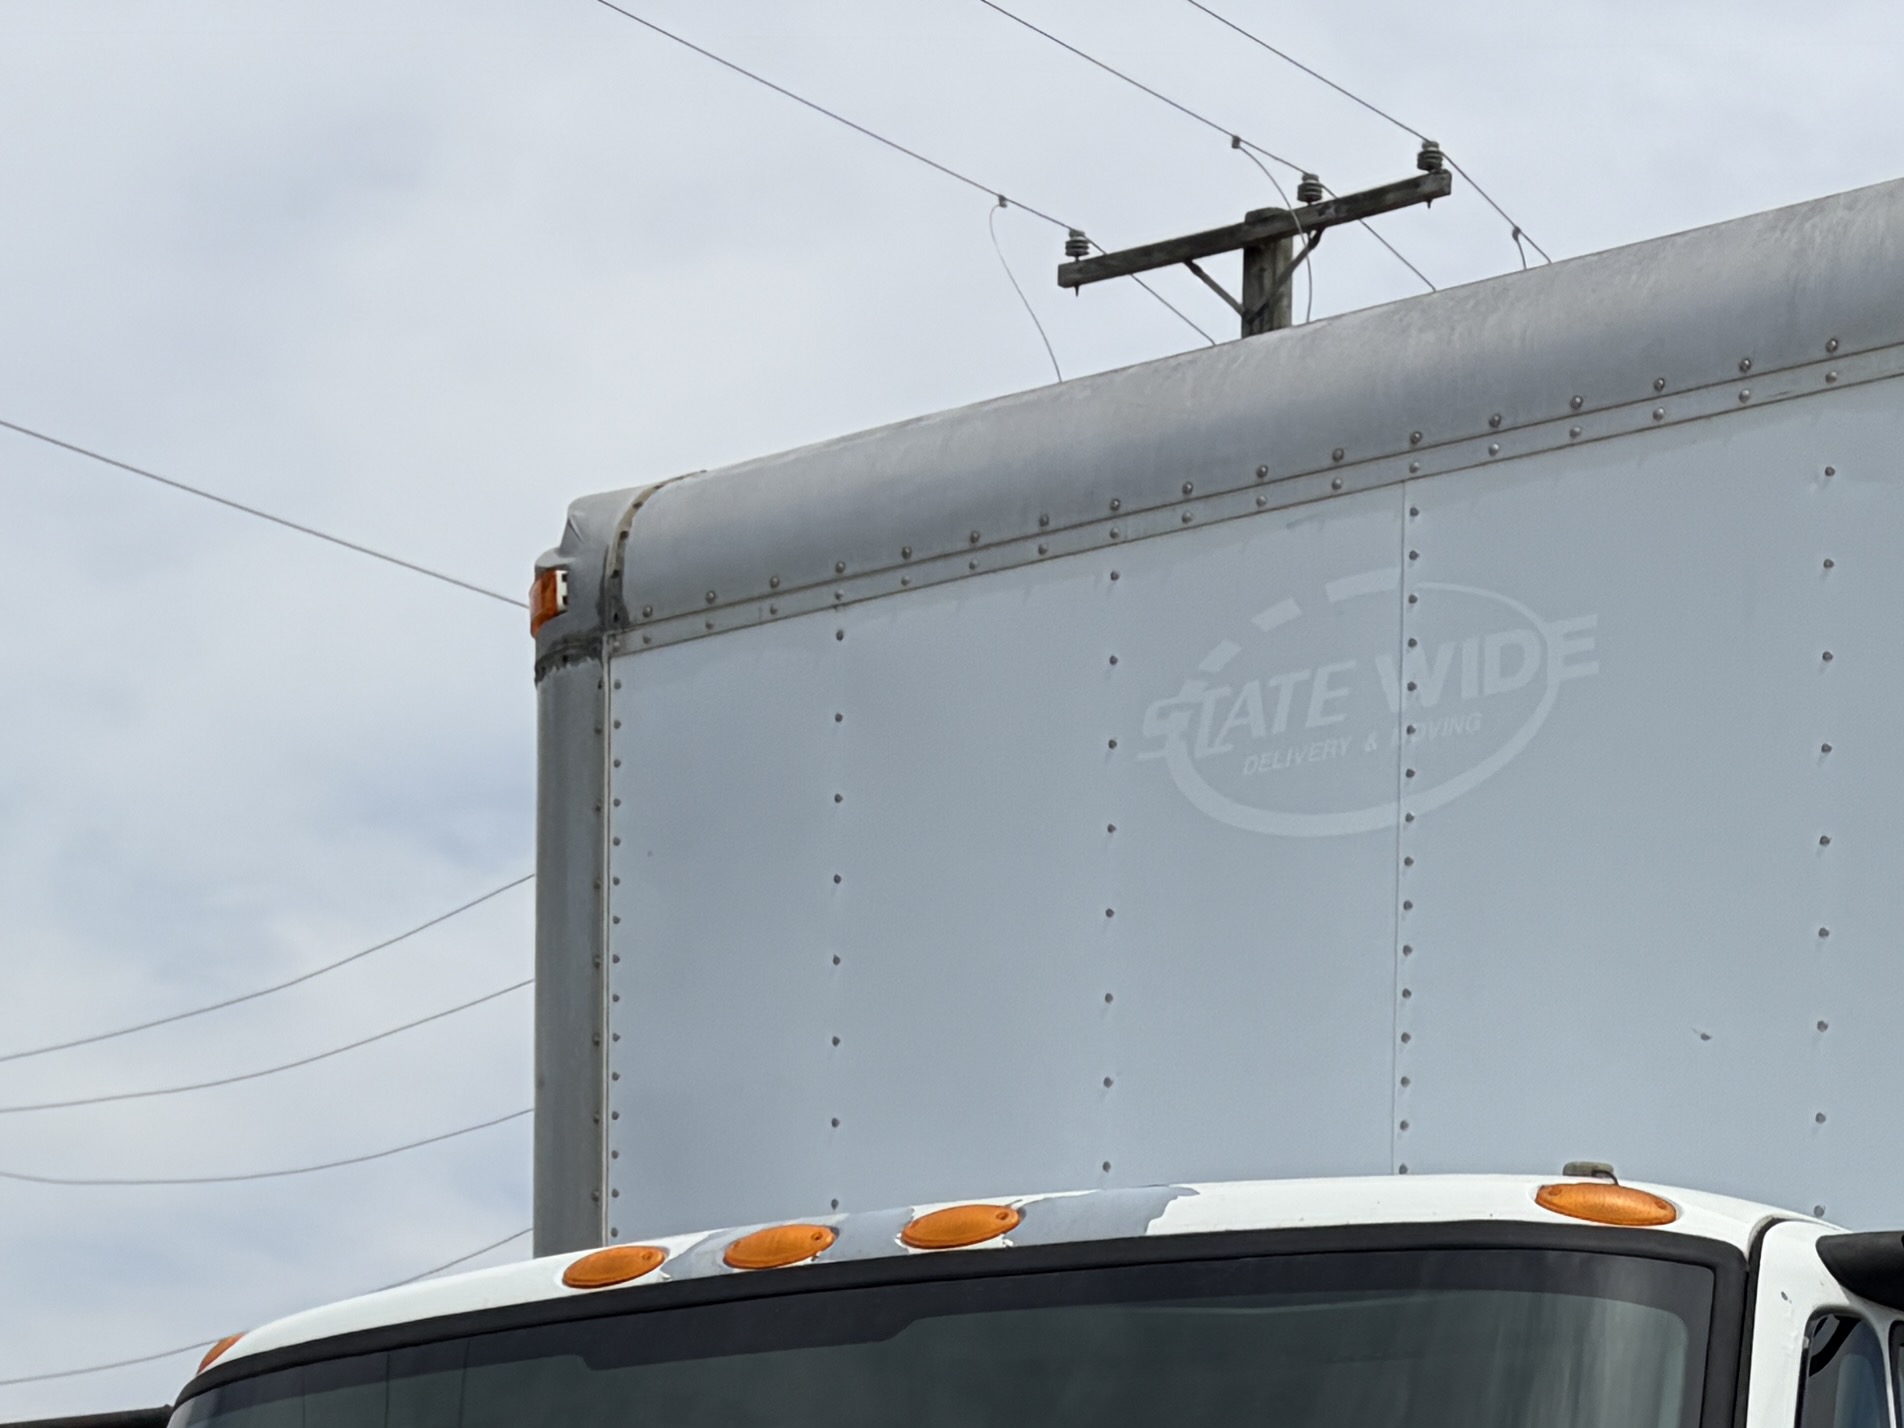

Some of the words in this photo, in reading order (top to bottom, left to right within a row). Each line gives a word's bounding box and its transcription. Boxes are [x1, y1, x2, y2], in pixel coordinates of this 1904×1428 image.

[1136, 658, 1356, 761] STATE
[1375, 612, 1600, 713] WIDE
[1242, 736, 1352, 776] DELIVERY
[1389, 711, 1484, 750] MOVING
